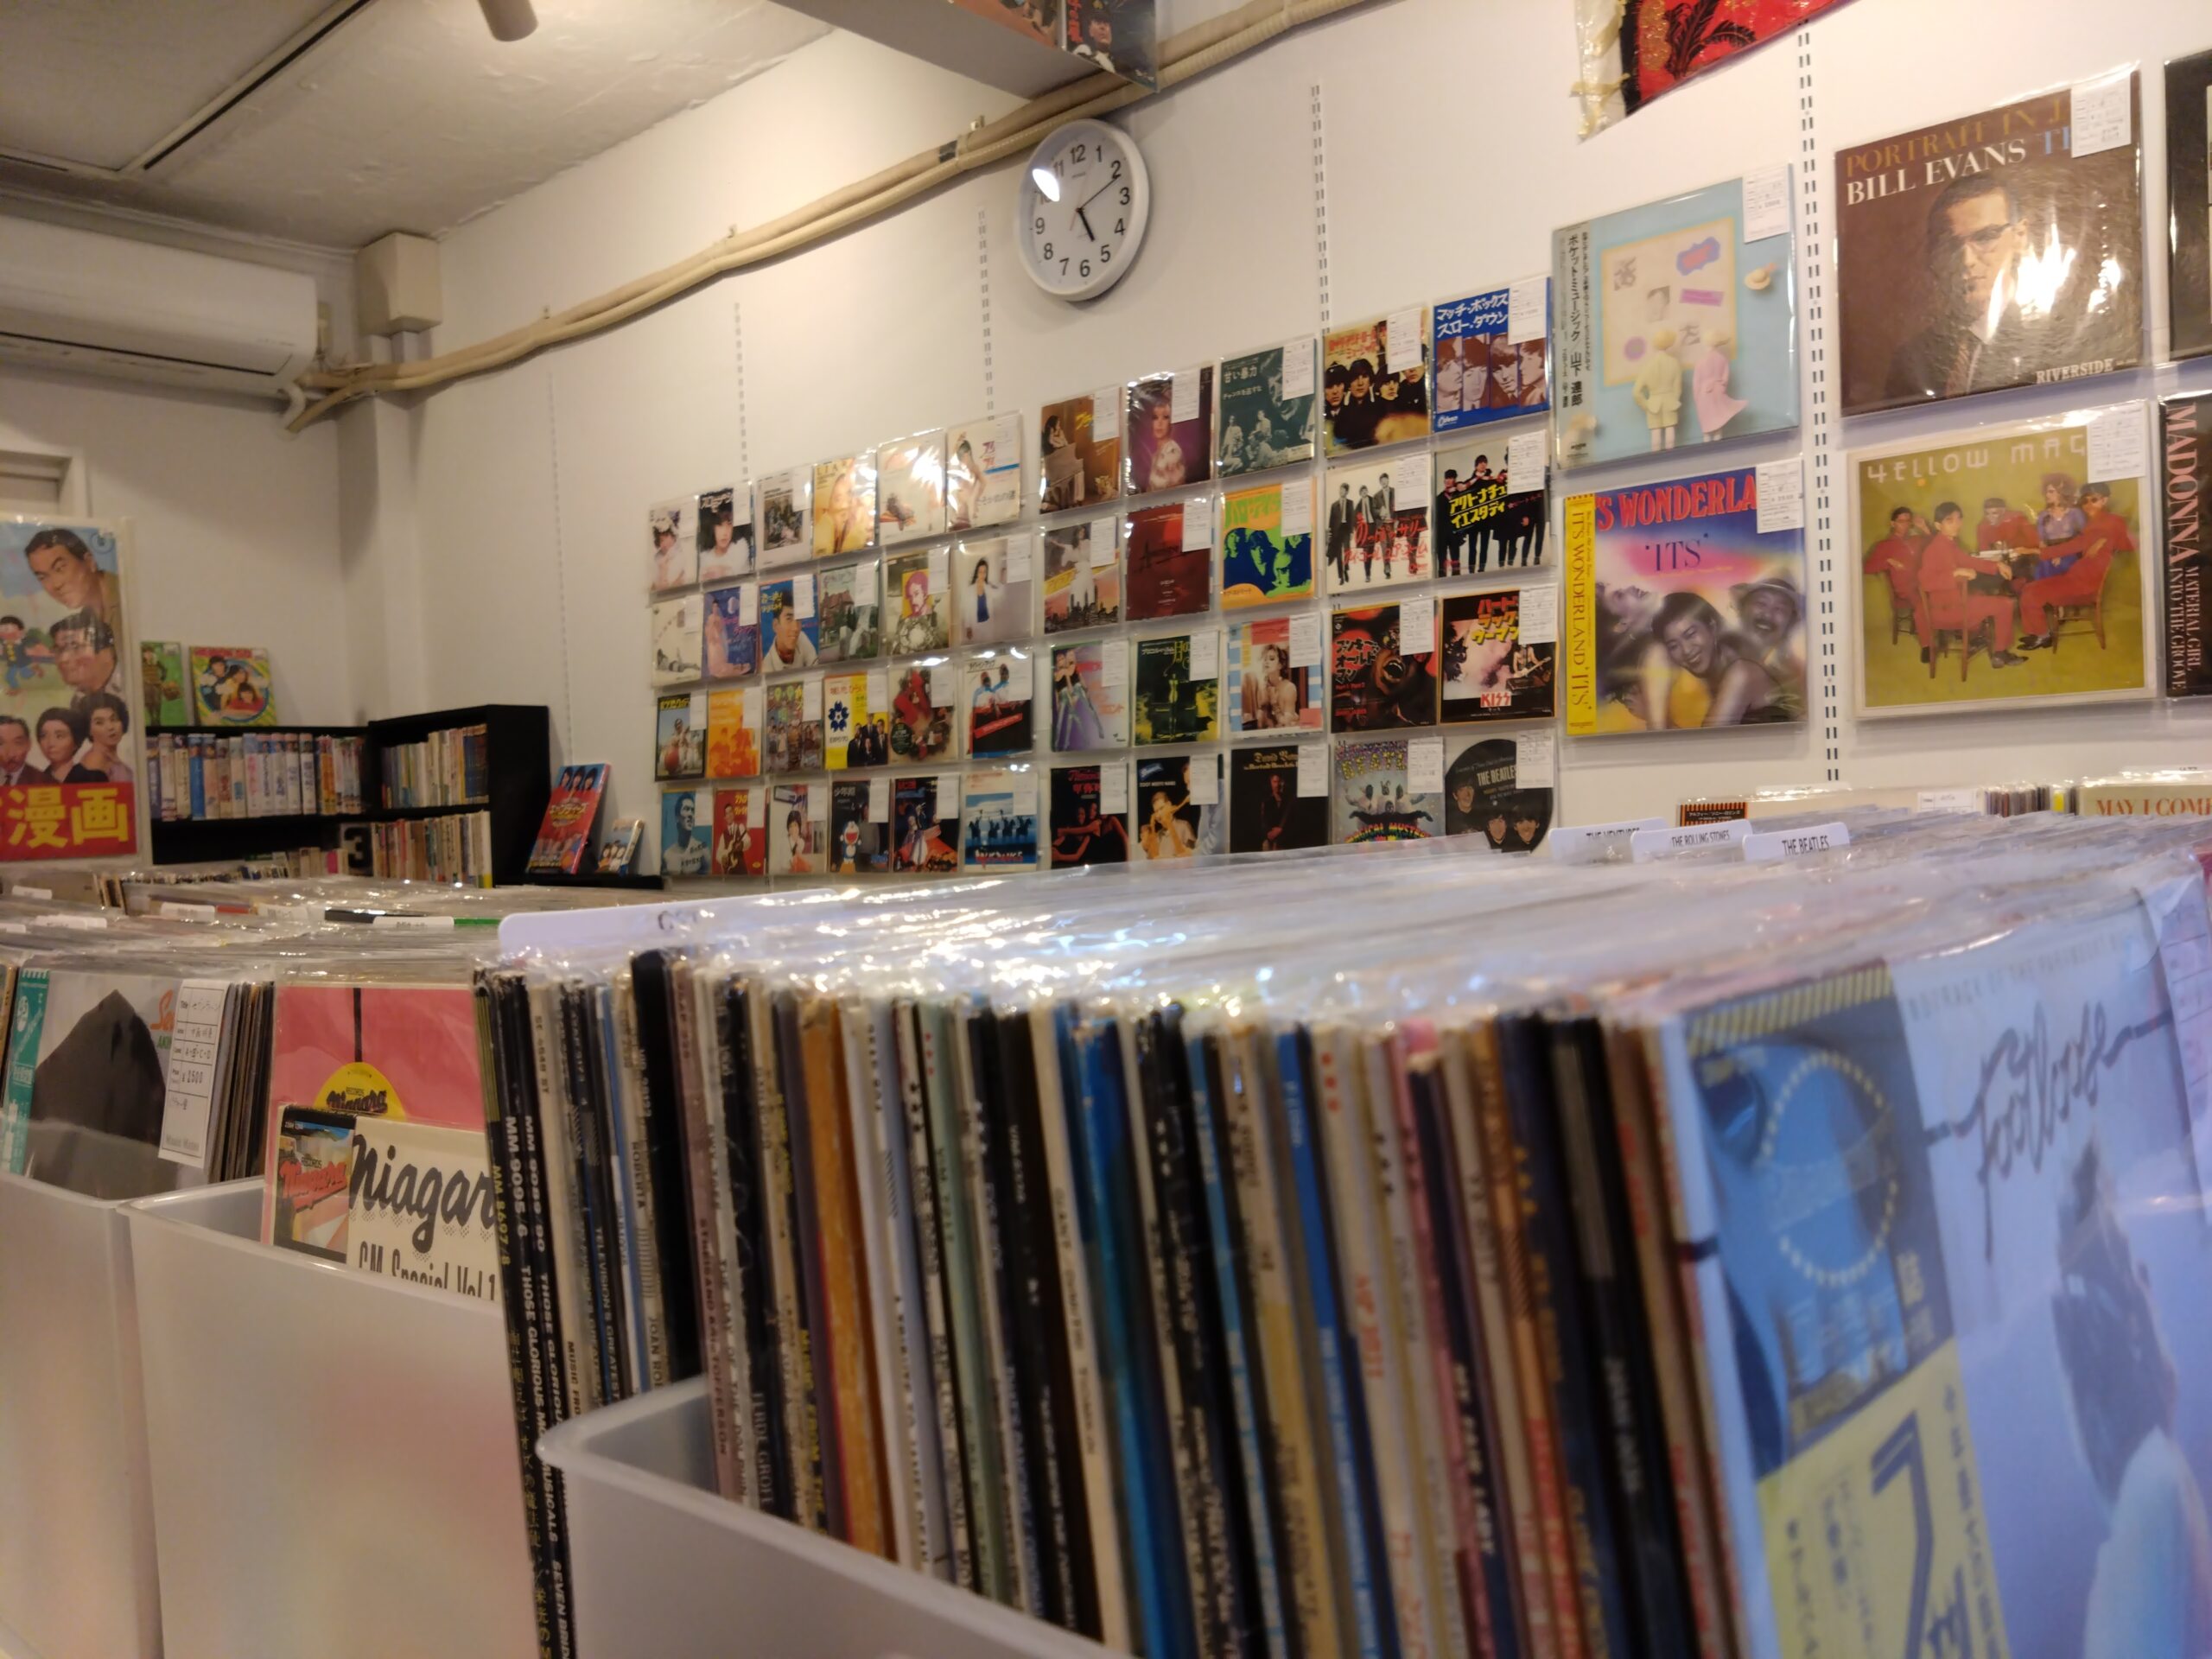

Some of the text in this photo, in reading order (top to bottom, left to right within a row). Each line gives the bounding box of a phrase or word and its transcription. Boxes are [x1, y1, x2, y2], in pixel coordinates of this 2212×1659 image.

[1071, 144, 1085, 164] 12
[1096, 145, 1102, 162] 1
[1846, 119, 1985, 177] PORTRAIT
[2003, 110, 2036, 135] IN
[1111, 161, 1121, 180] 2
[1847, 172, 1915, 205] BILL
[1925, 139, 2026, 187] EVANS
[1120, 188, 1130, 205] 3
[1035, 218, 1045, 234] 9
[1115, 219, 1125, 236] 4
[1044, 243, 1053, 259] 8
[1101, 245, 1111, 262] 5
[1059, 257, 1069, 276] 7
[1080, 260, 1090, 276] 6
[2036, 358, 2113, 385] RIVERSIDE
[1867, 451, 1988, 484] YELLOW
[2166, 403, 2201, 565] MADONNA
[1569, 543, 1586, 665] WONDERLAND
[2185, 566, 2202, 671] MATERIAL GIRL
[2170, 568, 2187, 690] INTO THE GROOVE
[1481, 693, 1511, 707] KISS
[1477, 768, 1494, 787] THE
[6, 785, 130, 852] 漫画
[1671, 830, 1731, 848] THE ROLLING STONES
[1781, 835, 1830, 856] THE BEATLES
[505, 1116, 518, 1152] MM
[492, 1164, 505, 1194] MM
[524, 1115, 537, 1152] MM
[539, 1273, 556, 1333] THOSE
[629, 1141, 646, 1209] ROBERTA
[648, 1316, 660, 1354] JOAN
[520, 1266, 536, 1321] THOSE
[526, 1325, 544, 1407] GLORIOUS
[566, 1340, 580, 1384] MUSIC
[550, 1559, 568, 1615] SEVEN
